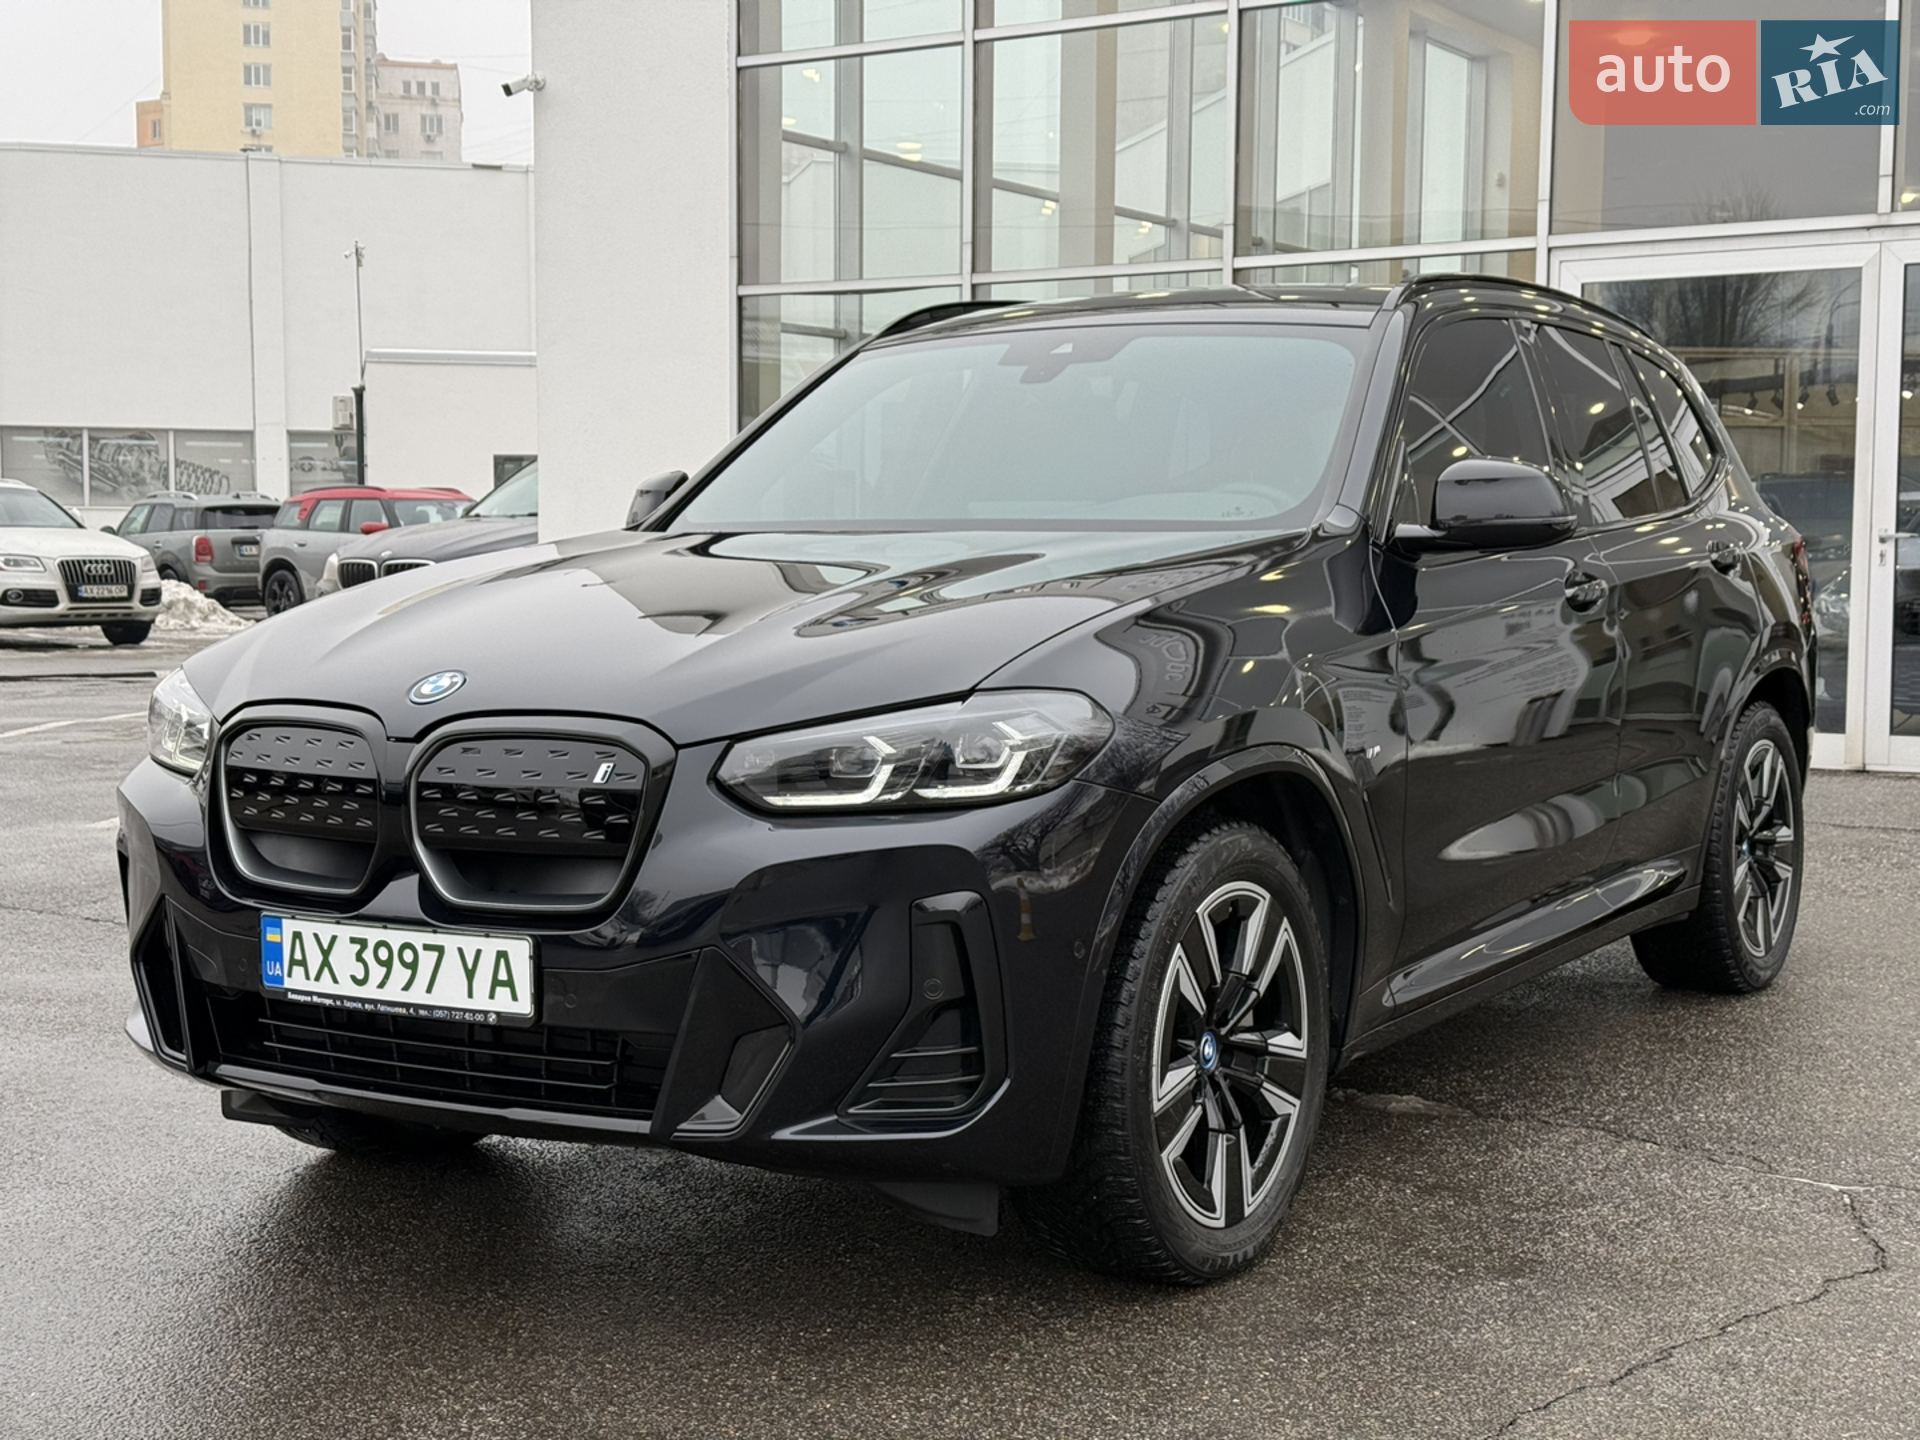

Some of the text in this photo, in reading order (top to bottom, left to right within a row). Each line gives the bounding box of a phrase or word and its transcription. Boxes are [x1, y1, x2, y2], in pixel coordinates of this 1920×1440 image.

[266, 961, 283, 977] UA
[287, 930, 519, 1002] AX 3997 YA
